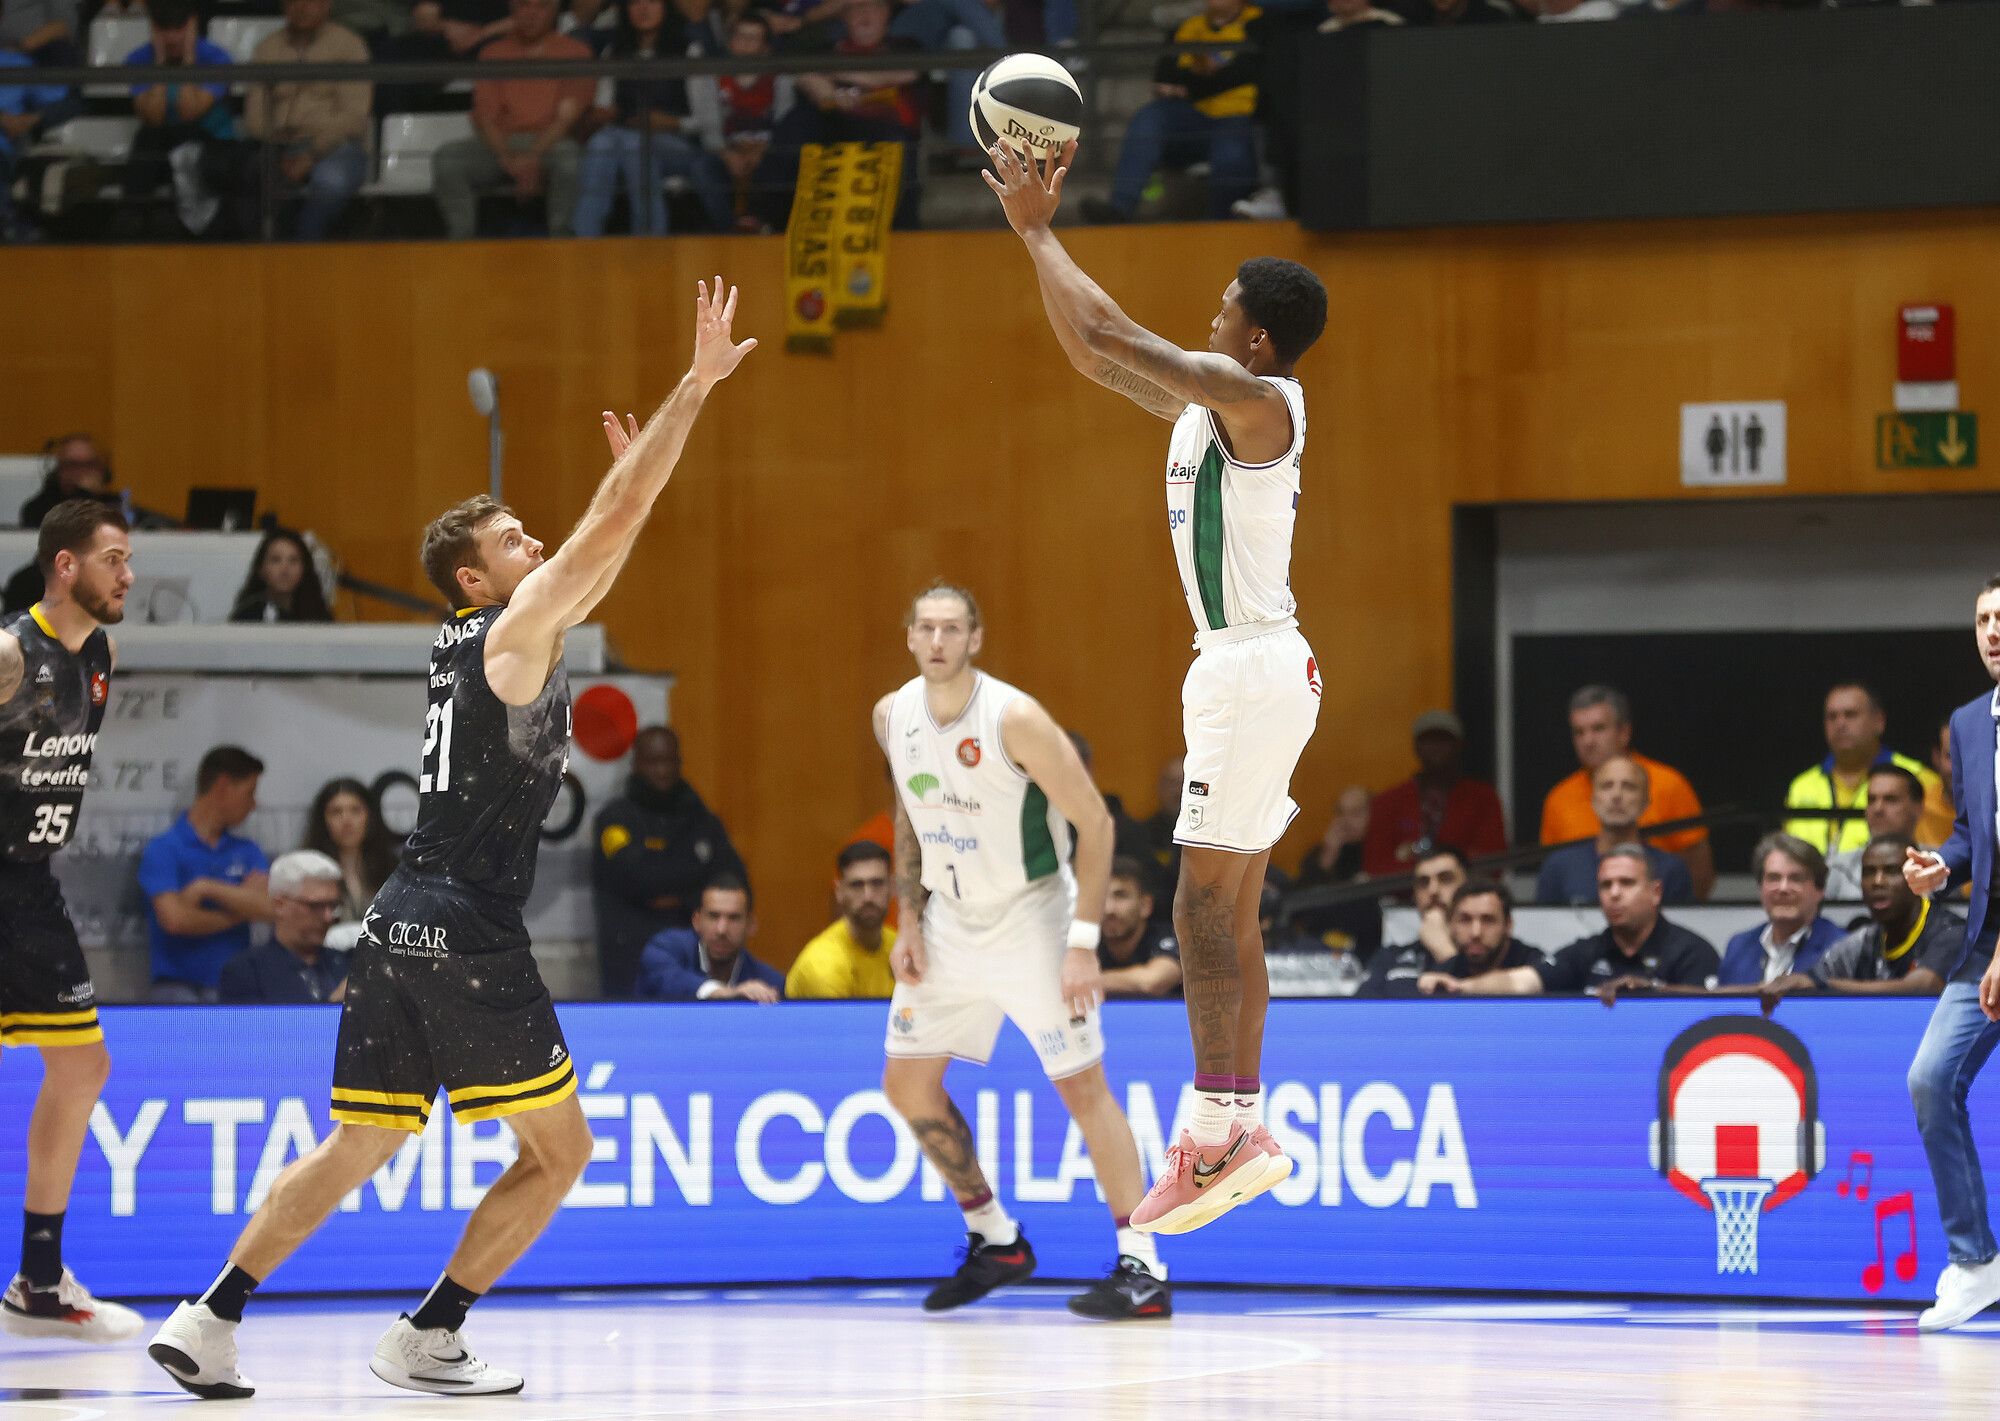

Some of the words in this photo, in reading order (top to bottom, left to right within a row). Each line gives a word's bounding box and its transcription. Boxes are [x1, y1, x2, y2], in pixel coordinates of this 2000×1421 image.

[1003, 118, 1065, 154] SPALD
[419, 697, 454, 793] 21
[27, 803, 74, 844] 35
[388, 921, 449, 950] CICAR
[407, 947, 433, 958] Islands
[433, 950, 449, 958] Car
[88, 1099, 168, 1217] Y
[184, 1062, 713, 1215] TAMBÉN
[1126, 1081, 1479, 1209] MSICA
